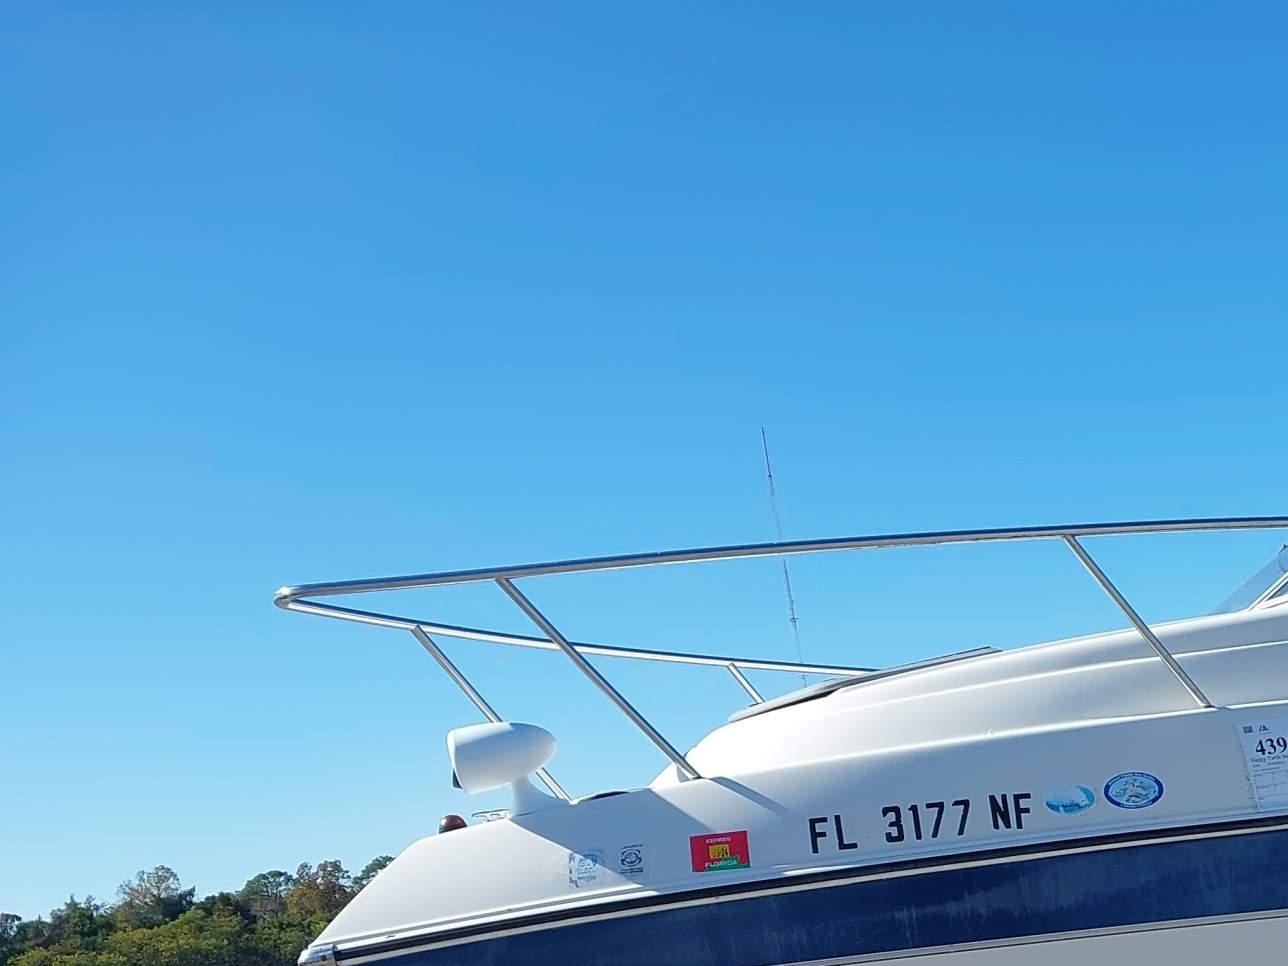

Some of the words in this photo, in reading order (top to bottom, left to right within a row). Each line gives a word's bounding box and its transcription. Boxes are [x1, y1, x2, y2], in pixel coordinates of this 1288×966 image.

[808, 816, 858, 854] FL
[882, 799, 971, 843] 3177
[991, 792, 1033, 831] NF
[704, 858, 738, 868] FLORIDA
